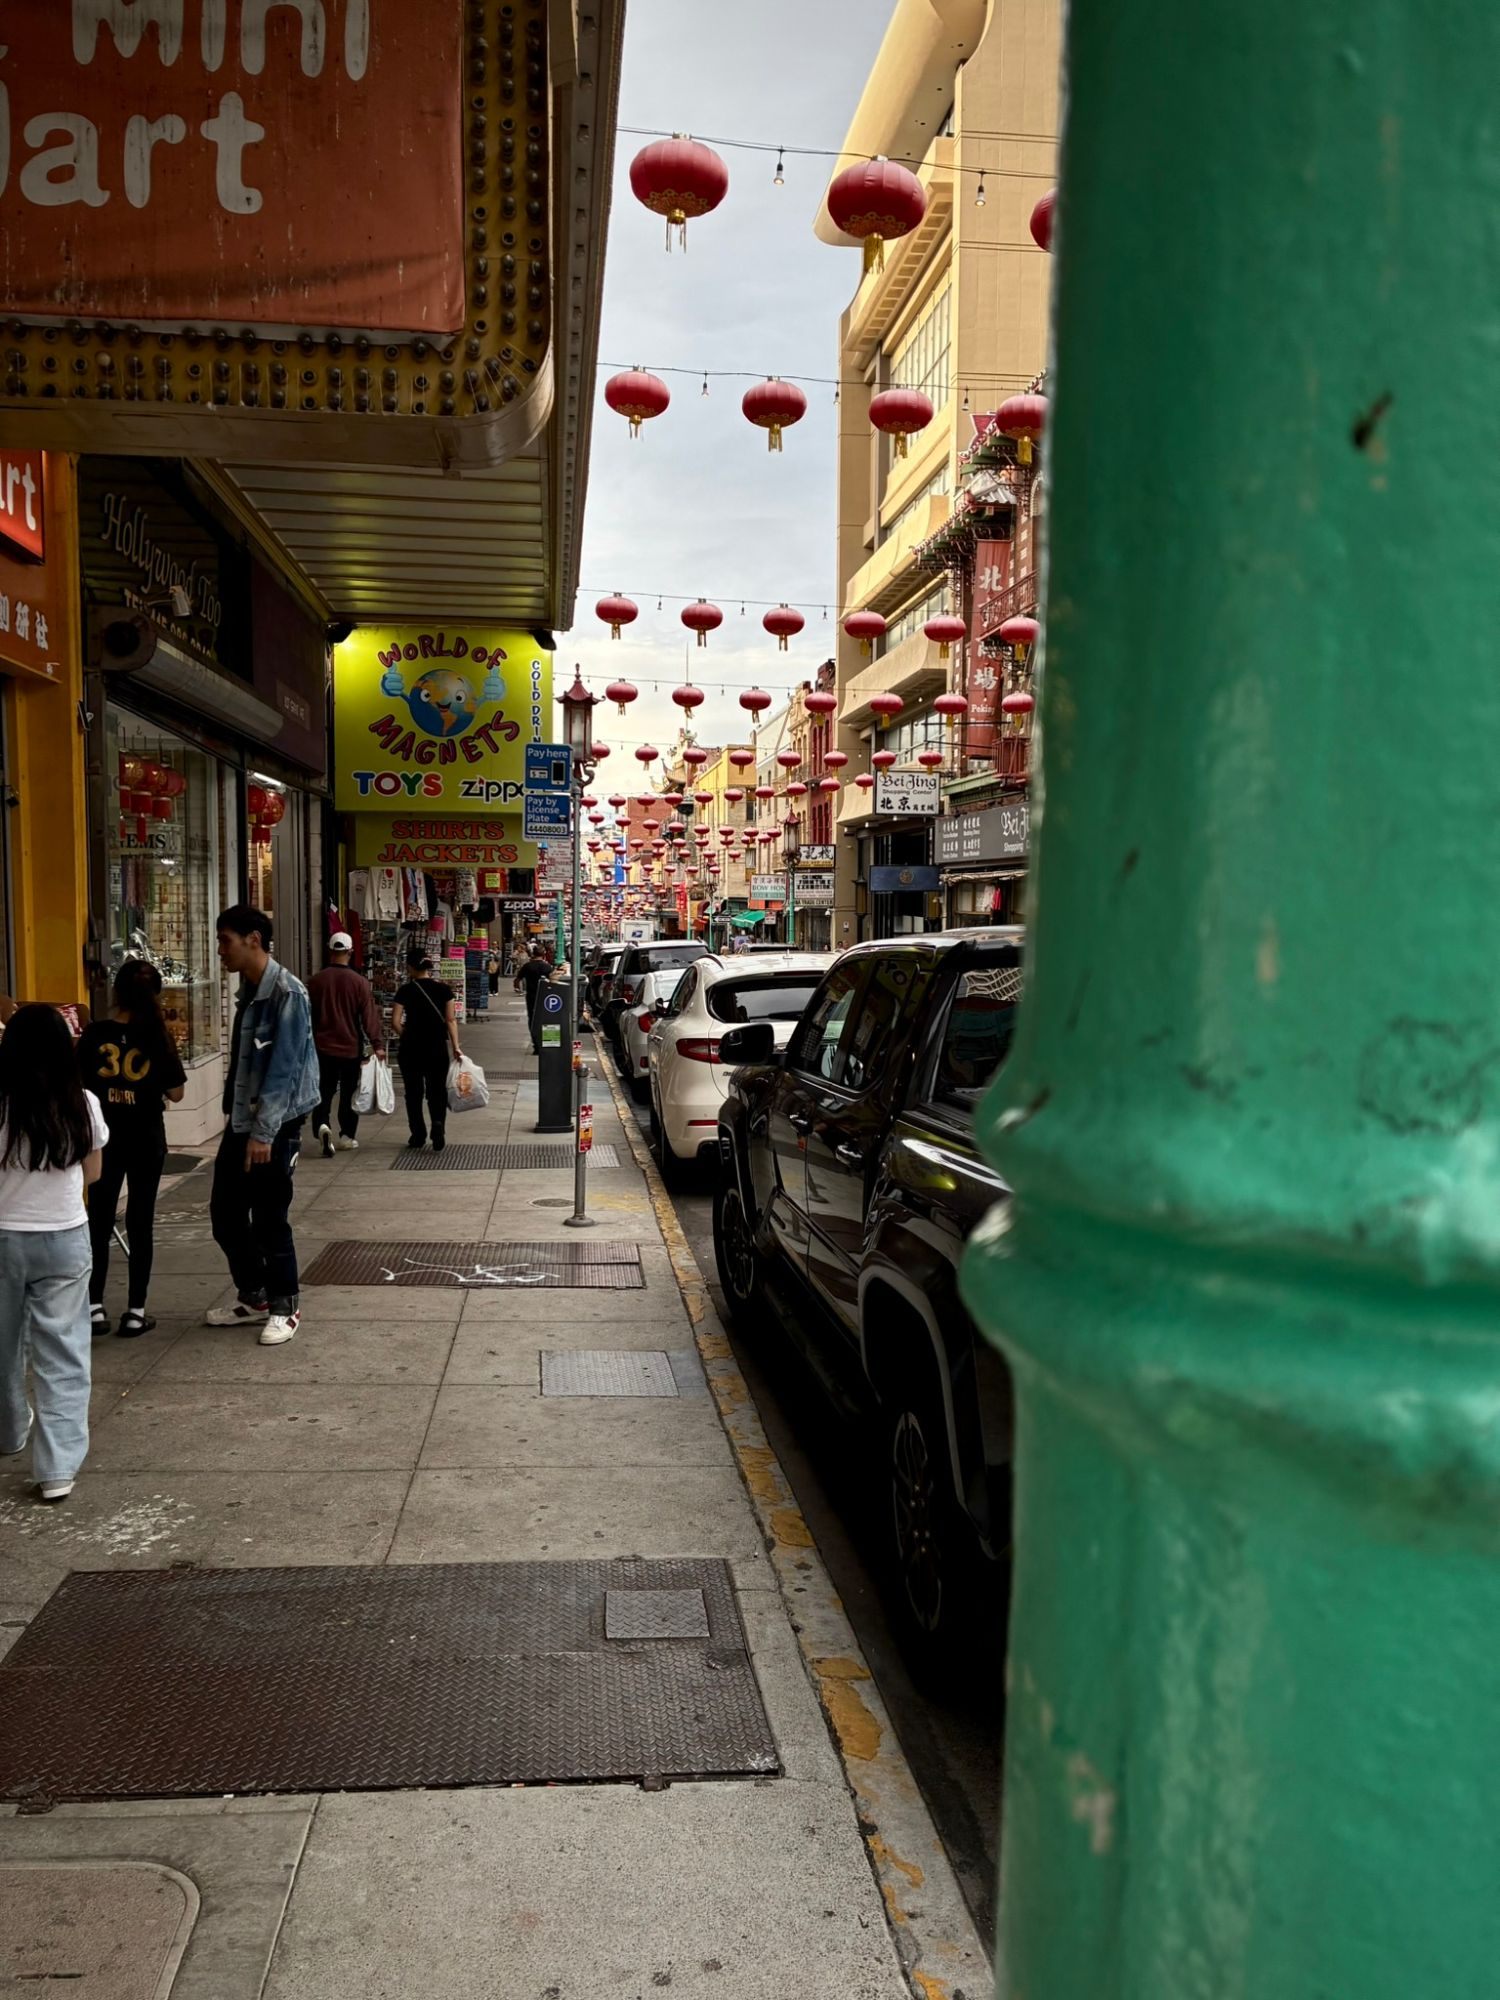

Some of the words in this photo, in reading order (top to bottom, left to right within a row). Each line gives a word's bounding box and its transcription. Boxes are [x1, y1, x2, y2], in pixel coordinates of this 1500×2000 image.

[0, 82, 265, 214] art
[0, 462, 37, 531] rt
[197, 575, 222, 627] Too
[378, 632, 469, 668] WORLD
[531, 660, 541, 700] COLD
[369, 710, 521, 765] MAGNETS
[527, 748, 545, 759] Pay
[547, 748, 568, 758] here
[353, 772, 442, 797] TOYS
[879, 774, 905, 787] Bei
[906, 774, 937, 790] Jing
[527, 797, 544, 806] Pay
[546, 797, 557, 806] by
[527, 805, 560, 813] License
[527, 814, 550, 822] Plate
[1001, 811, 1019, 836] Bei
[391, 820, 505, 840] SHIRTS
[528, 825, 566, 833] 44408003
[377, 843, 518, 863] JACKETS
[1004, 842, 1024, 853] Shopping
[381, 879, 394, 889] SF
[503, 900, 535, 910] zippo
[549, 997, 558, 1009] P
[97, 1042, 151, 1082] 30
[107, 1087, 136, 1105] CURY
